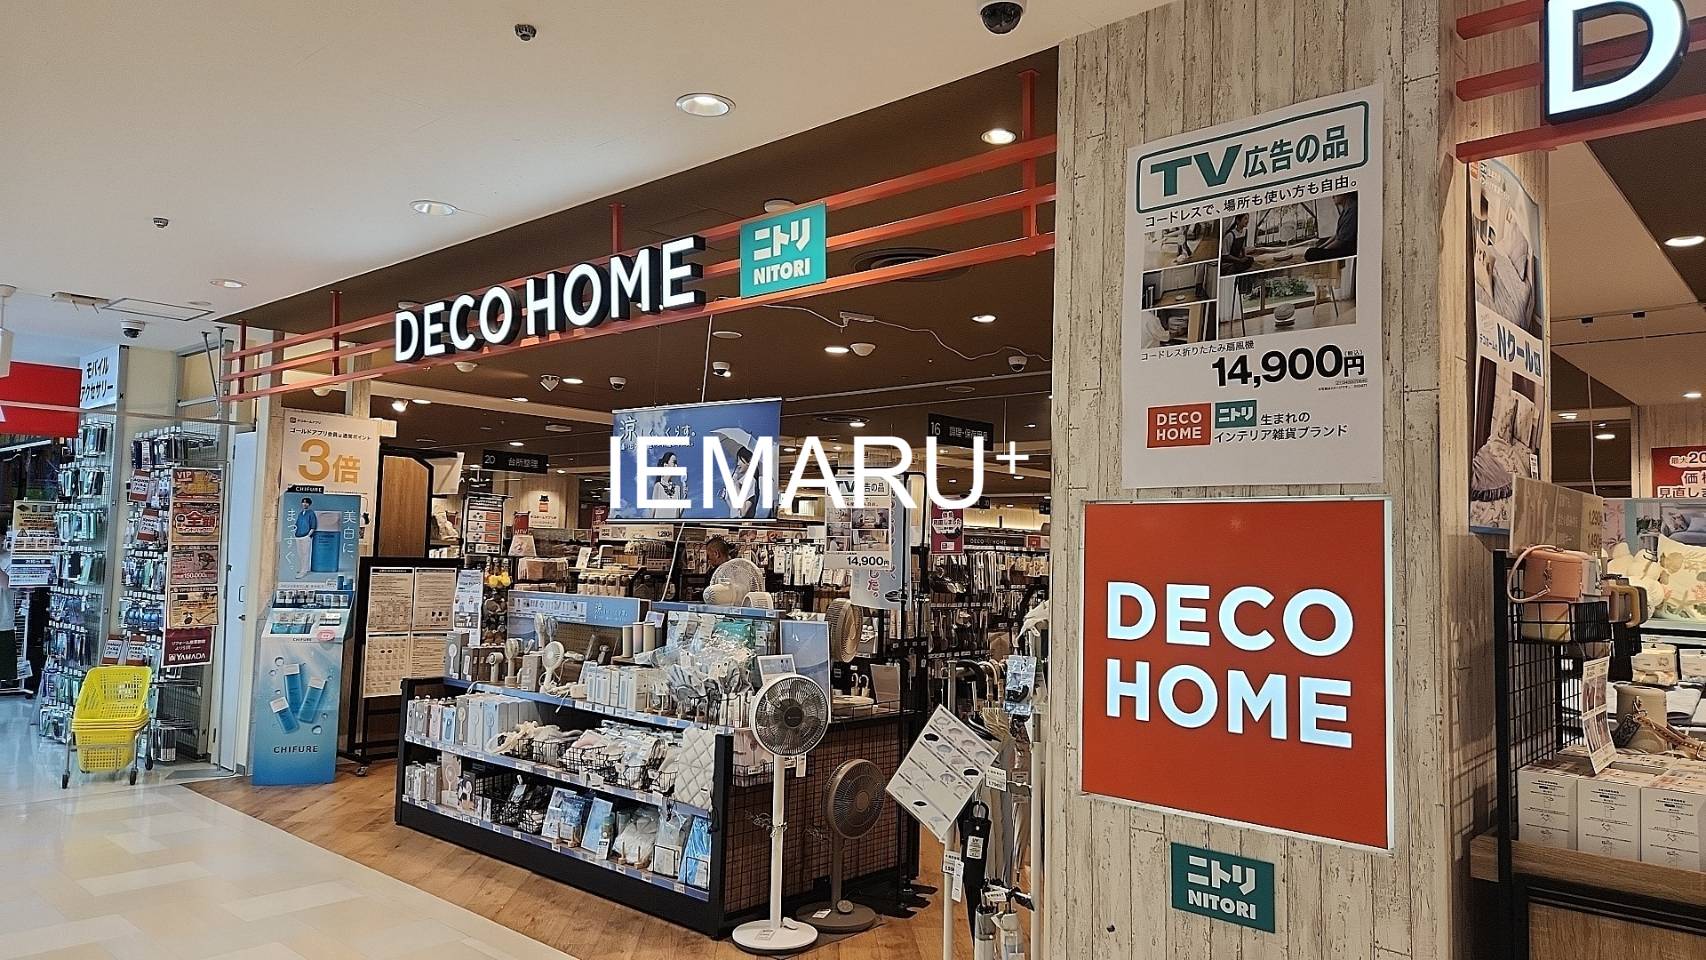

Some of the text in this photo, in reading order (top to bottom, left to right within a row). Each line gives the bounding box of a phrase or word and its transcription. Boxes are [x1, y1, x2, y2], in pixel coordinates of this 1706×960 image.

[1145, 175, 1358, 228] コードレスで、場所も使い方も自由。
[753, 217, 811, 261] ニトリ
[753, 257, 811, 286] NITORI
[394, 236, 700, 363] DECO HOME
[1141, 340, 1254, 361] コードレス折りたたみ扇風機
[86, 357, 109, 379] モバイル
[931, 421, 941, 436] 16
[1156, 411, 1203, 426] DECO
[1218, 406, 1311, 426] ニトリ 生まれの
[1156, 427, 1203, 441] HOME
[1214, 424, 1348, 443] インテリア雑貨ブランド
[298, 438, 361, 484] 3倍
[484, 454, 496, 465] 20
[342, 510, 356, 560] 美白に、
[1106, 581, 1355, 657] DECO
[1106, 658, 1353, 749] HOME
[273, 745, 319, 754] CHIFURE
[1187, 855, 1257, 896] ニトリ
[1187, 889, 1257, 921] NITORI
